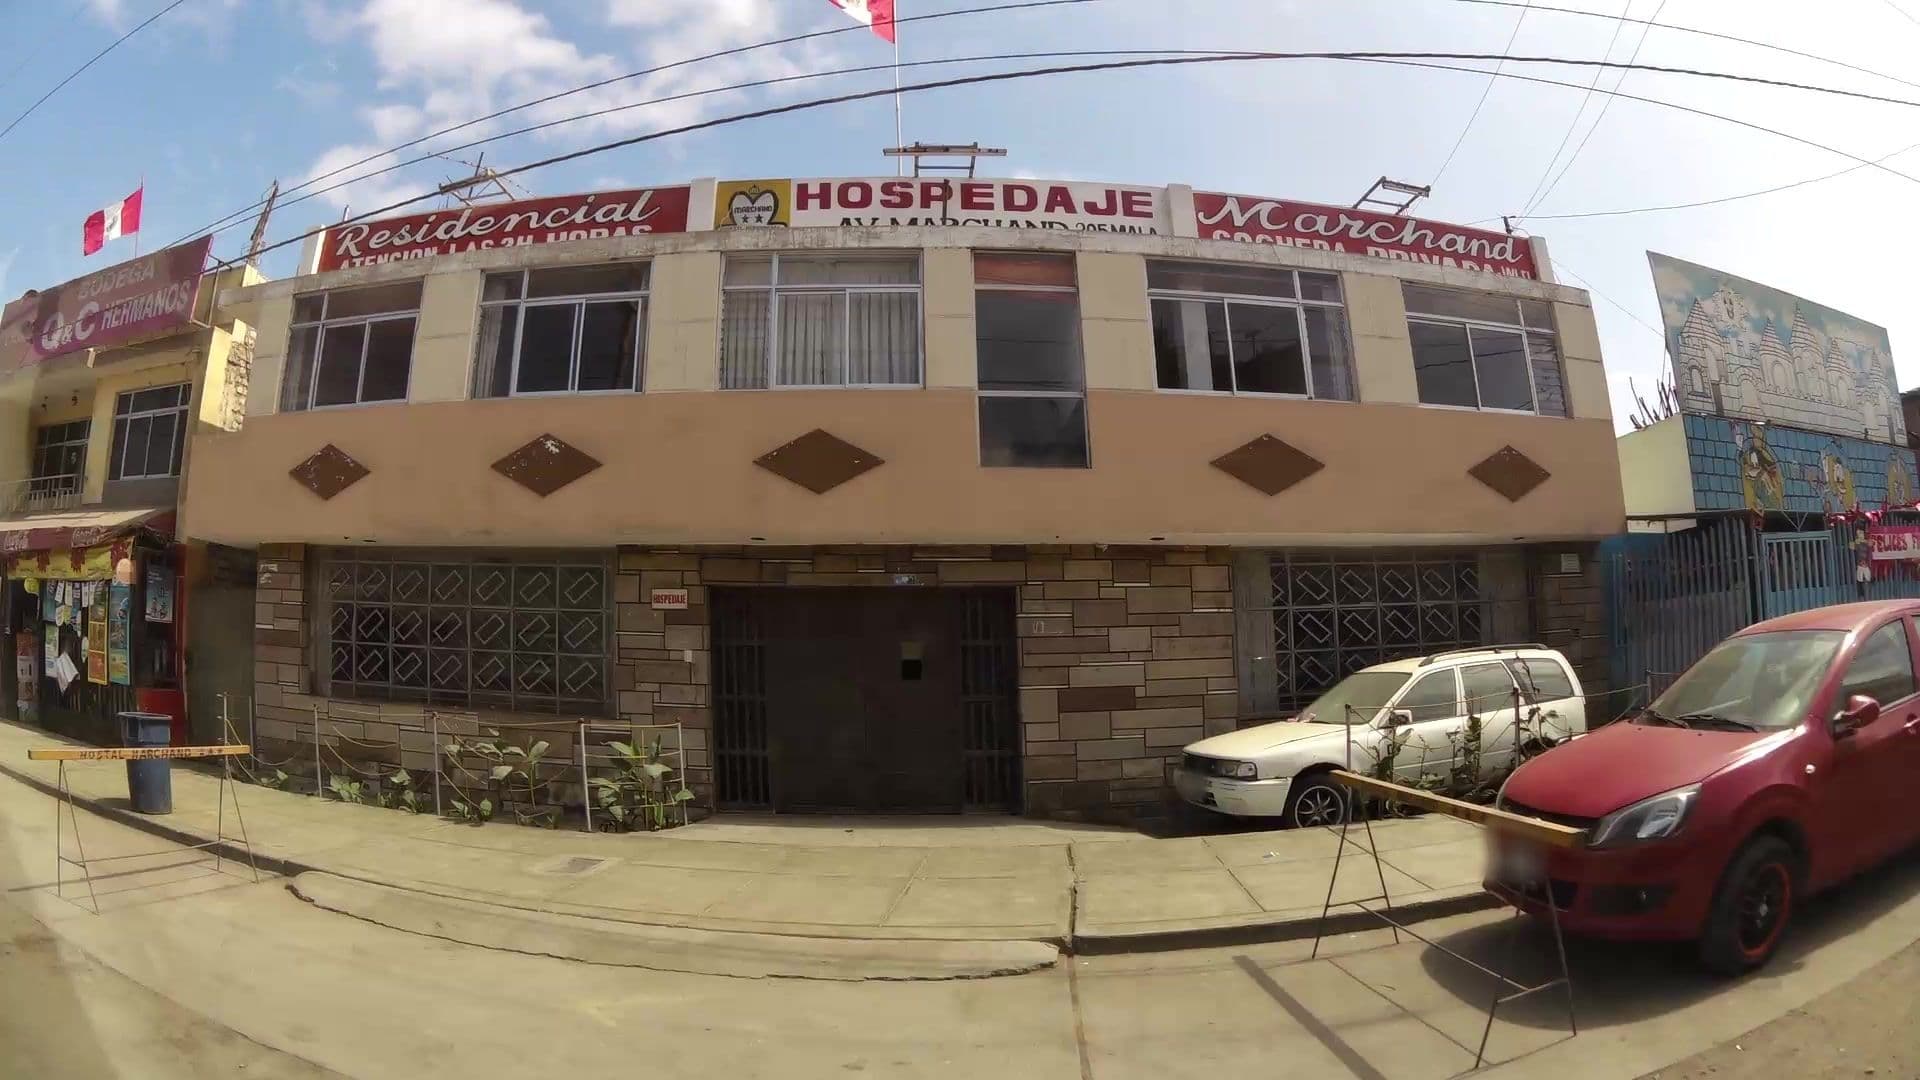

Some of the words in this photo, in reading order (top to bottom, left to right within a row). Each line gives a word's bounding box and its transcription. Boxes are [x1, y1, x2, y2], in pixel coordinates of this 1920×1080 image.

[336, 190, 661, 257] Residencial
[796, 181, 1154, 218] HOSPEDAJE
[1198, 196, 1523, 263] Marchand
[101, 280, 191, 331] HERMANOS
[79, 750, 125, 760] HOSTAL
[132, 748, 191, 760] MARCHAND
